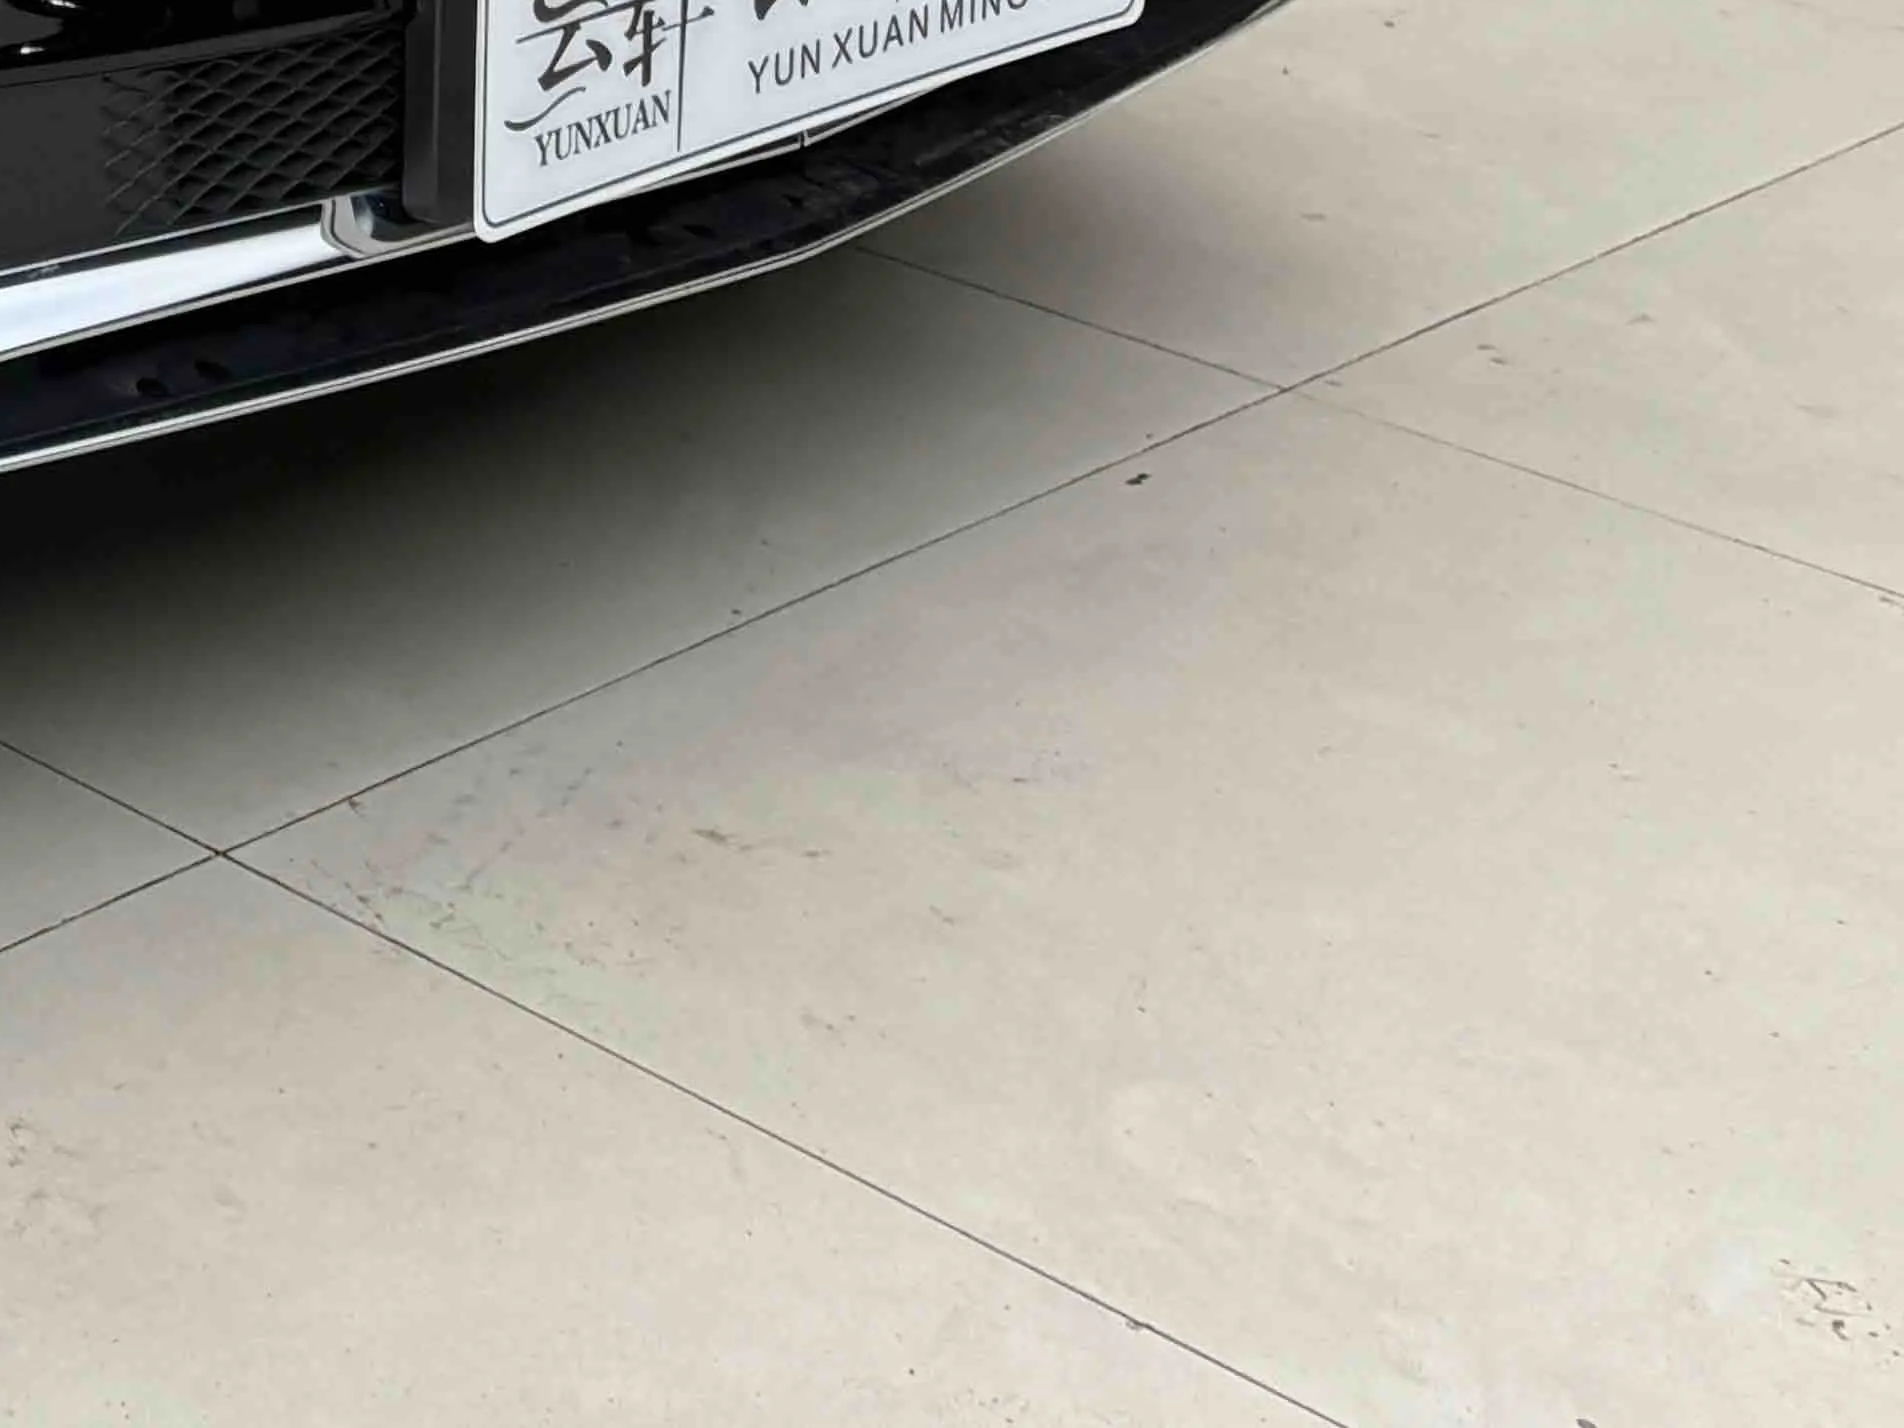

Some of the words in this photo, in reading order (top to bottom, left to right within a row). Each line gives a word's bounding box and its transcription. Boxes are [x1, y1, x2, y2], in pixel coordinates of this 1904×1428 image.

[748, 40, 822, 95] YUN
[831, 4, 930, 70] XUAN
[534, 89, 673, 168] YUNXUAN
